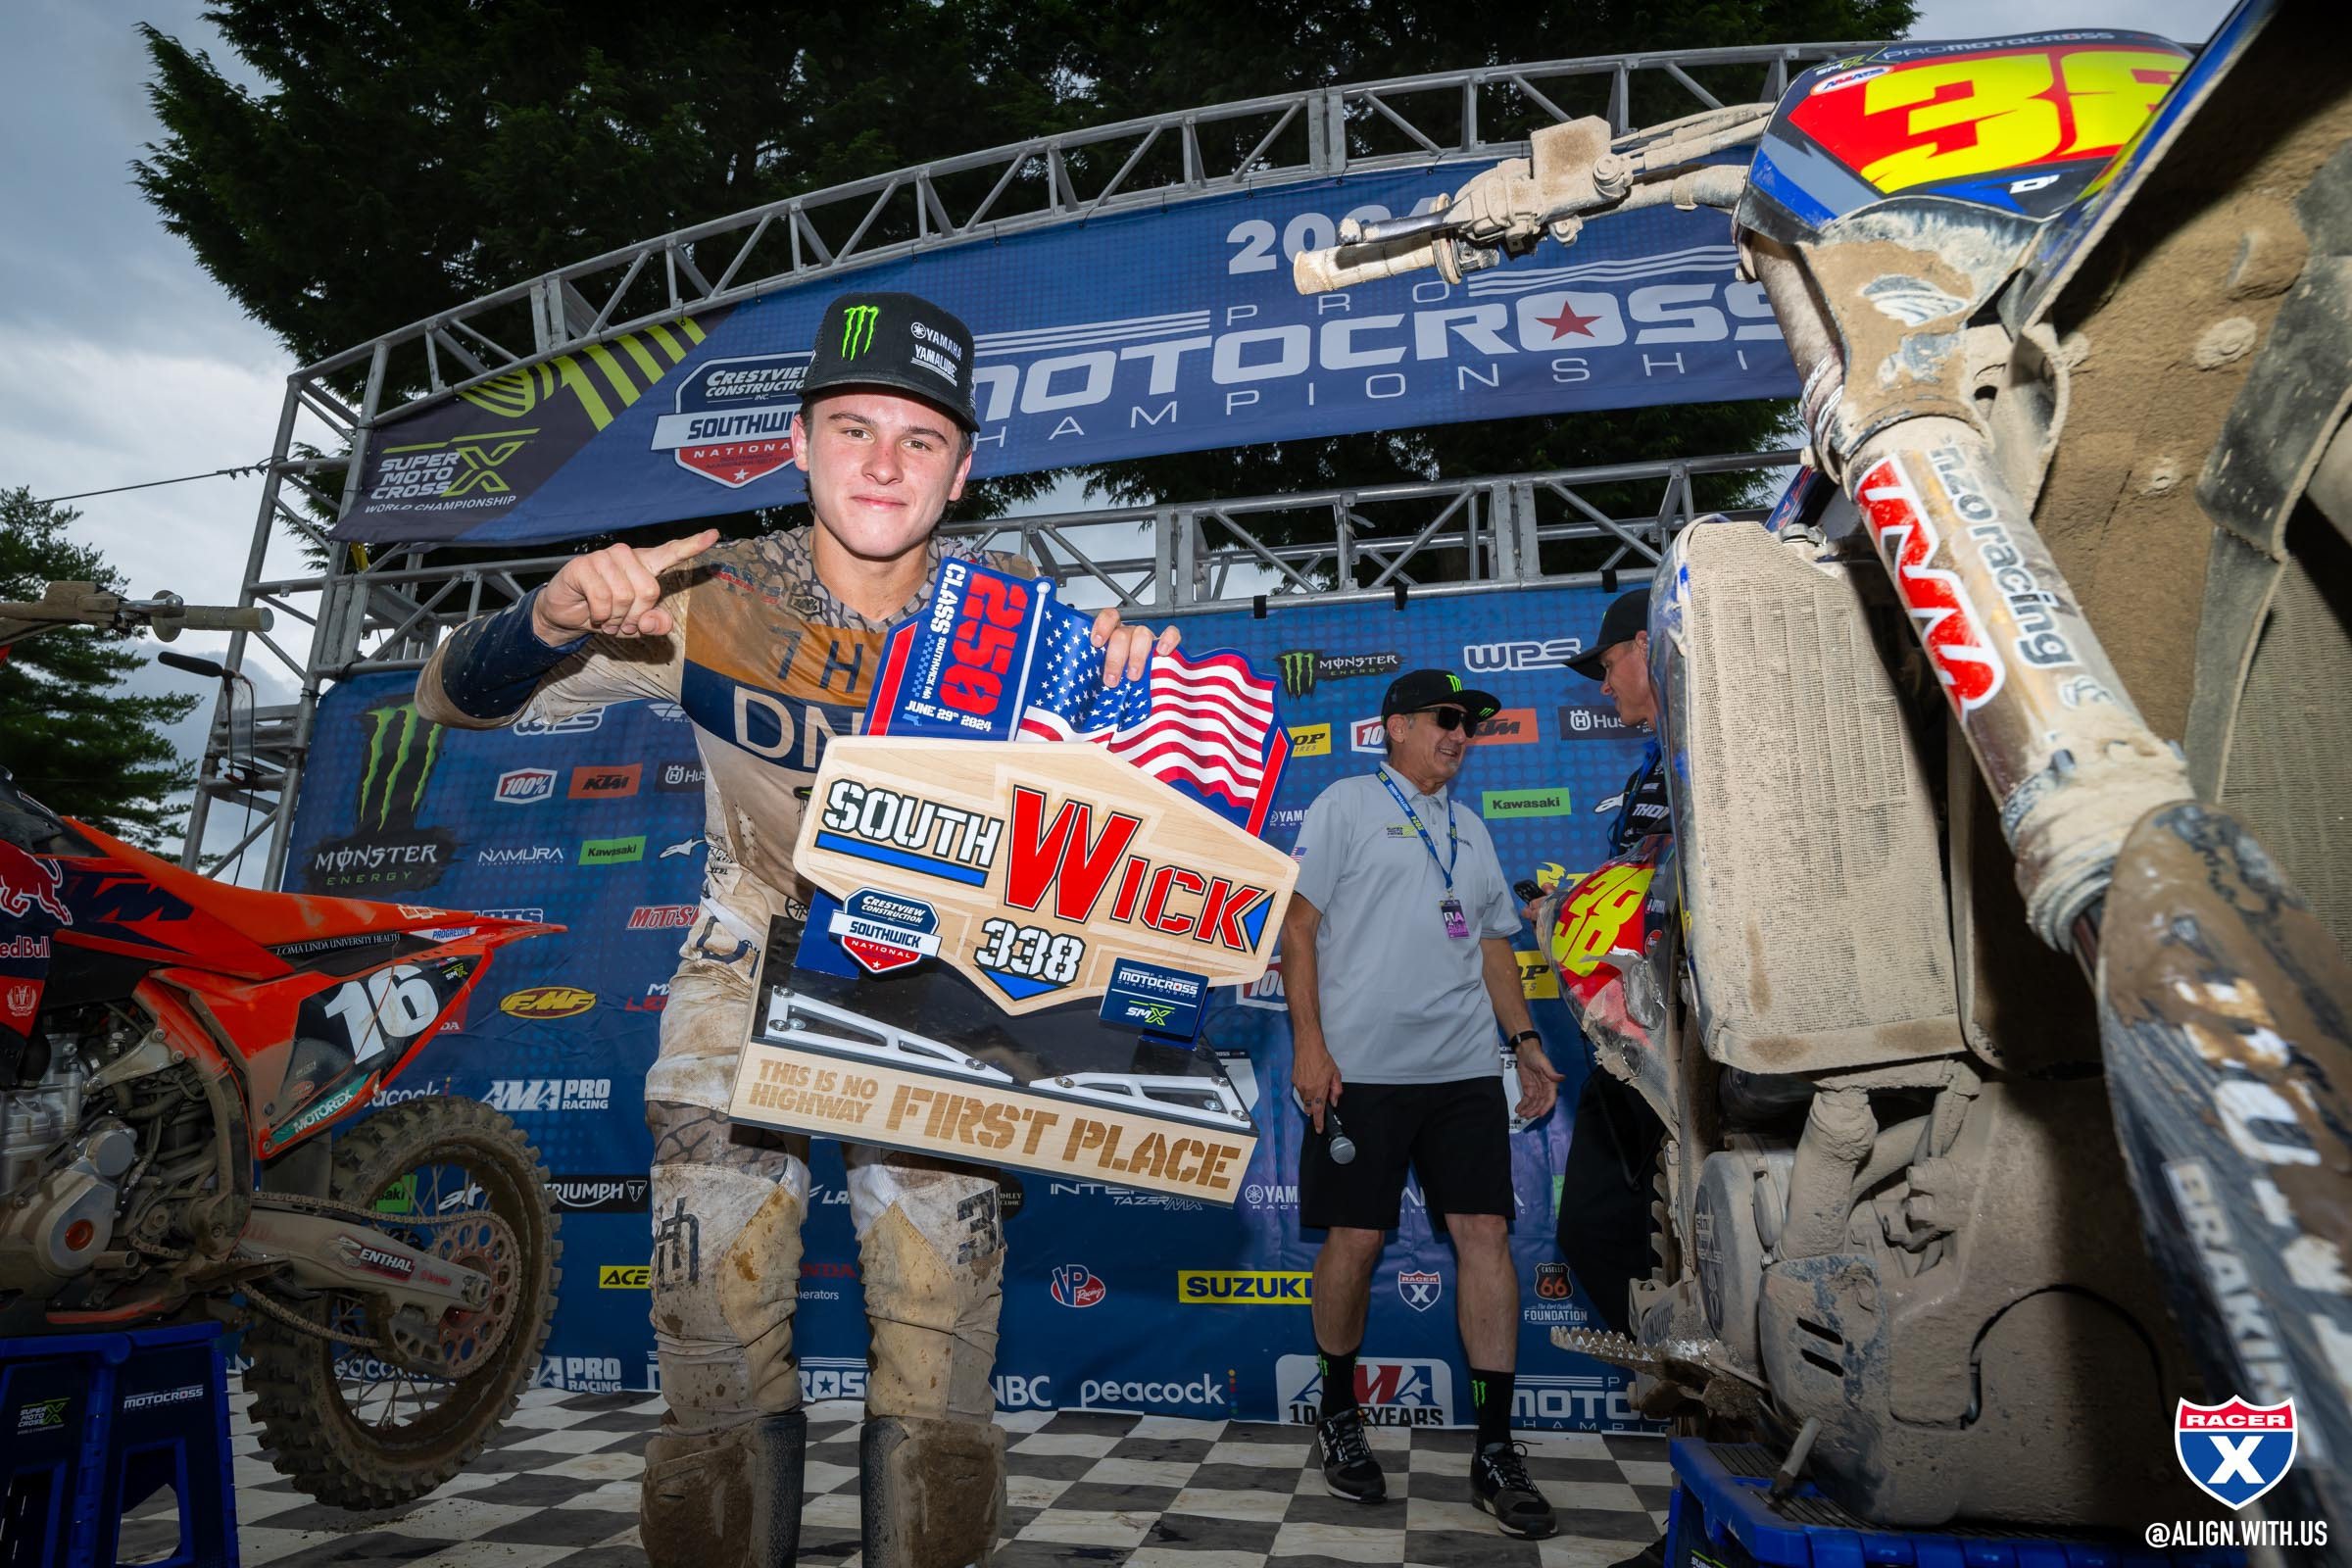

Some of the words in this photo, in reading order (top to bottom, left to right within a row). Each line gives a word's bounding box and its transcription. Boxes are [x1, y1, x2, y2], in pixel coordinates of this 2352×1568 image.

[1226, 198, 1438, 275] 20
[1227, 279, 1450, 327] PRO
[925, 326, 963, 362] YAMAHA
[914, 343, 958, 378] YAMALUBE
[706, 366, 809, 386] CRESTVIE
[687, 411, 799, 440] SOUTHWI
[378, 451, 461, 472] SUPER
[379, 466, 455, 487] MOTO
[369, 480, 454, 500] CROSS
[364, 503, 414, 514] WORLD
[414, 495, 517, 512] CHAMPIONSHIP
[930, 563, 966, 635] CLASS
[938, 571, 1029, 716] 250
[926, 636, 948, 687] SOUTHWICK
[1319, 655, 1398, 669] MONSTER
[1464, 637, 1583, 673] WPS
[904, 700, 937, 717] JUNE
[960, 716, 992, 732] 2024
[503, 776, 549, 796] 100%
[582, 773, 629, 791] KTM
[1492, 797, 1561, 810] Kawasaki
[821, 778, 1004, 869] SOUTH
[315, 844, 438, 873] MONSTER
[477, 845, 564, 863] NAMURA
[587, 844, 637, 858] Kawasaki
[326, 870, 413, 886] ENERGY
[861, 904, 924, 924] CONSTRUCTION
[862, 895, 927, 917] CRESTVIEW
[276, 945, 304, 956] LOMA
[305, 940, 329, 952] LINDA
[329, 934, 372, 949] UNIVERSITY
[372, 932, 401, 943] HEALTH
[432, 927, 471, 940] PROGRESSIVE
[849, 920, 922, 949] SOUTHWICK
[851, 940, 911, 958] NATIONAL
[972, 916, 1087, 987] 338
[1118, 970, 1199, 996] MOTOCROSS
[503, 989, 595, 1015] FMF
[324, 964, 439, 1065] 16
[1125, 1006, 1172, 1026] SMX
[564, 1079, 612, 1099] PRO
[759, 1058, 811, 1088] THIS
[812, 1066, 839, 1093] IS
[842, 1073, 880, 1101] NO
[480, 1079, 563, 1111] AMA
[562, 1100, 610, 1110] RACING
[748, 1081, 873, 1124] HIGHWAY
[885, 1084, 1059, 1152] FIRST
[1060, 1117, 1243, 1190] PLACE
[1409, 1284, 1431, 1303] X
[1540, 1276, 1568, 1297] 66
[1524, 1309, 1588, 1321] FOUNDATION
[565, 1357, 622, 1381] PRO
[568, 1380, 622, 1392] RACING
[1080, 1372, 1225, 1408] peacock
[123, 1388, 204, 1409] MOTOCROSS
[1372, 1405, 1445, 1426] YEARS
